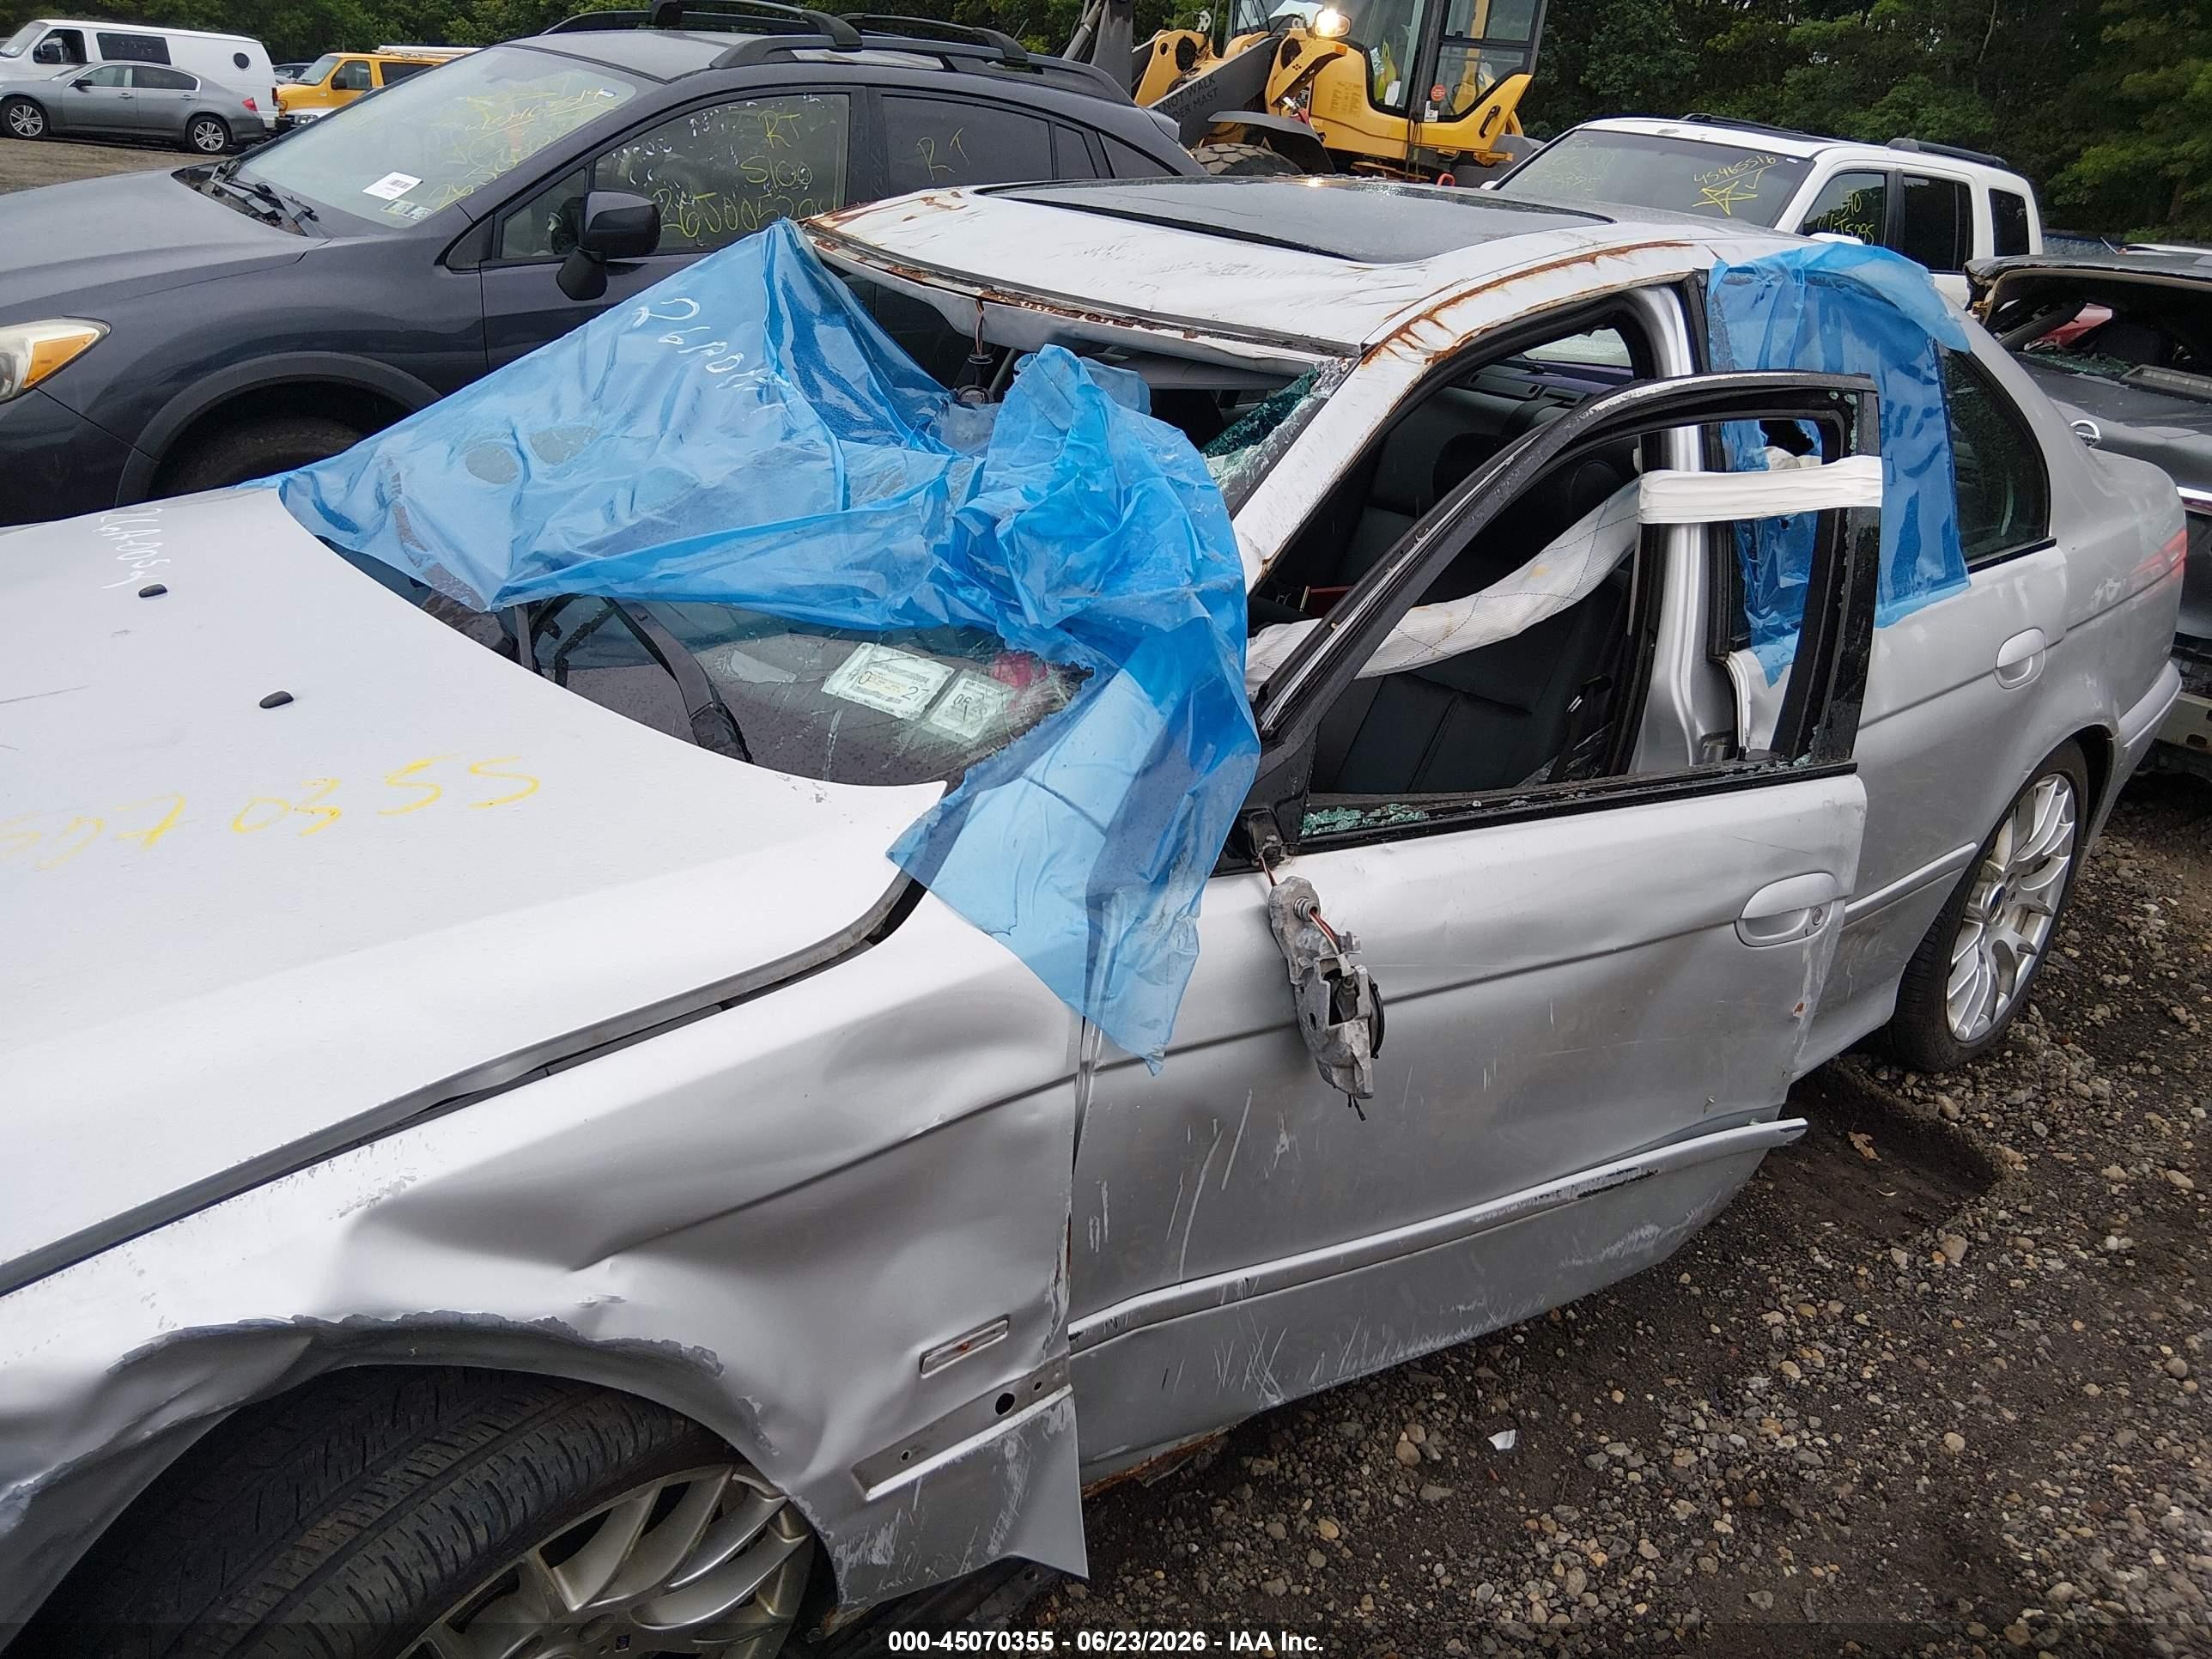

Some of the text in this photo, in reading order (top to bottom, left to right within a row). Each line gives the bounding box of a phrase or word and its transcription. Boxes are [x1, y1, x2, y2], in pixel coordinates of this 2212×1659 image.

[1163, 92, 1184, 110] NOT
[1187, 73, 1216, 96] WALK
[1193, 87, 1218, 108] MAST
[758, 110, 801, 149] RT
